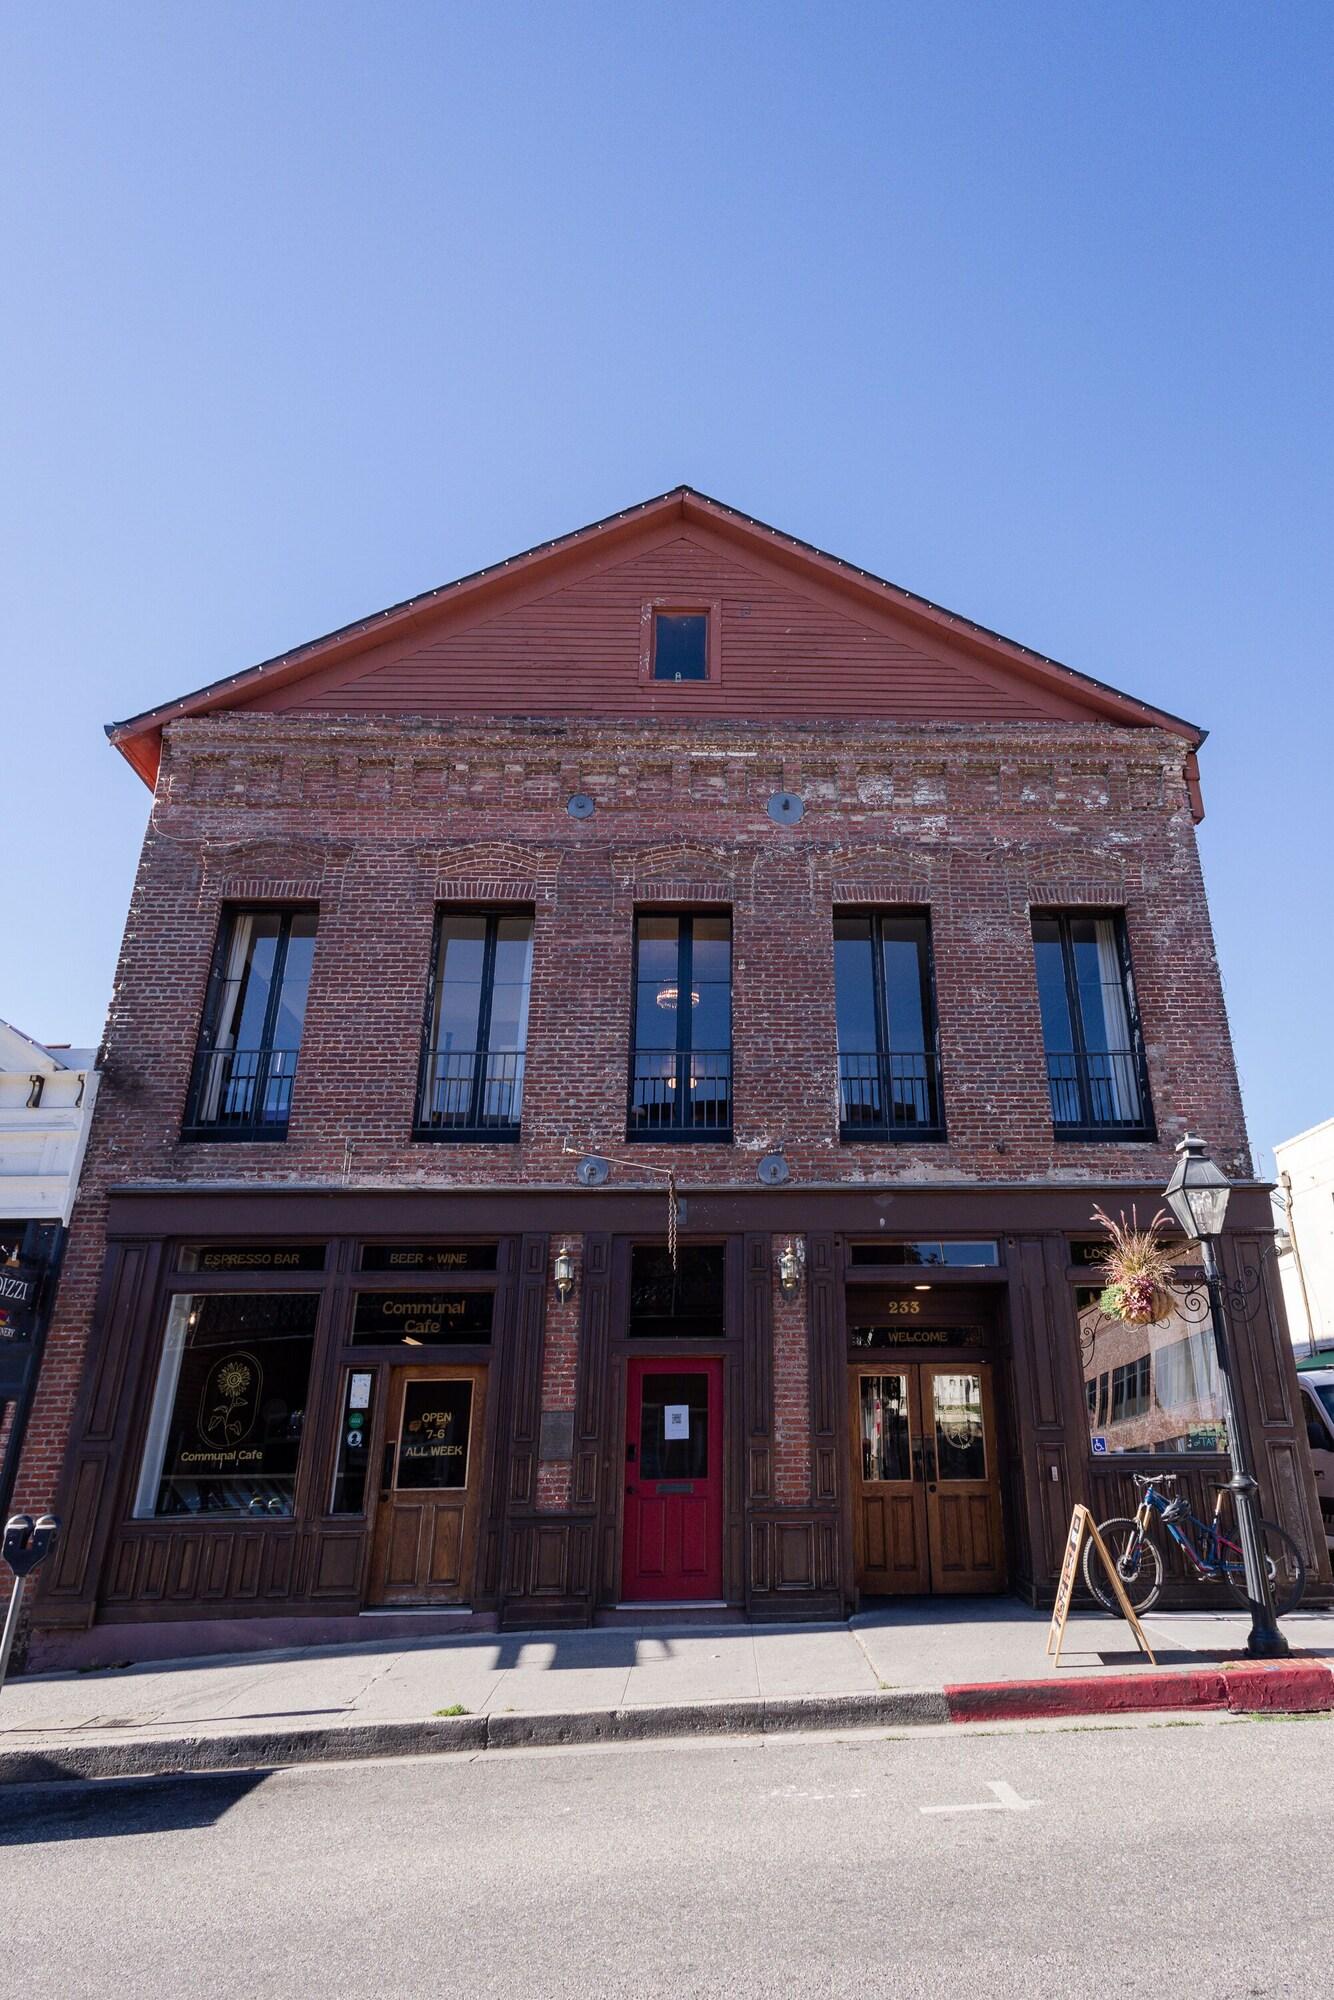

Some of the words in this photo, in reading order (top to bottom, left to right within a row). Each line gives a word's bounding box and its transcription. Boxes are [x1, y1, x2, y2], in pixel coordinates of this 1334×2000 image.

[205, 1254, 271, 1265] ESPRESSO
[274, 1253, 300, 1265] BAR
[390, 1253, 424, 1264] BEER
[437, 1253, 468, 1264] WINE
[382, 1299, 466, 1315] Communal
[888, 1301, 920, 1314] 233
[404, 1319, 441, 1333] Cafe
[887, 1331, 949, 1342] WELCOME
[422, 1412, 452, 1422] OPEN
[426, 1429, 445, 1439] 7-6
[181, 1450, 236, 1461] Communal
[238, 1449, 263, 1460] Cafe
[405, 1446, 428, 1457] ALL
[430, 1445, 463, 1456] WEEK
